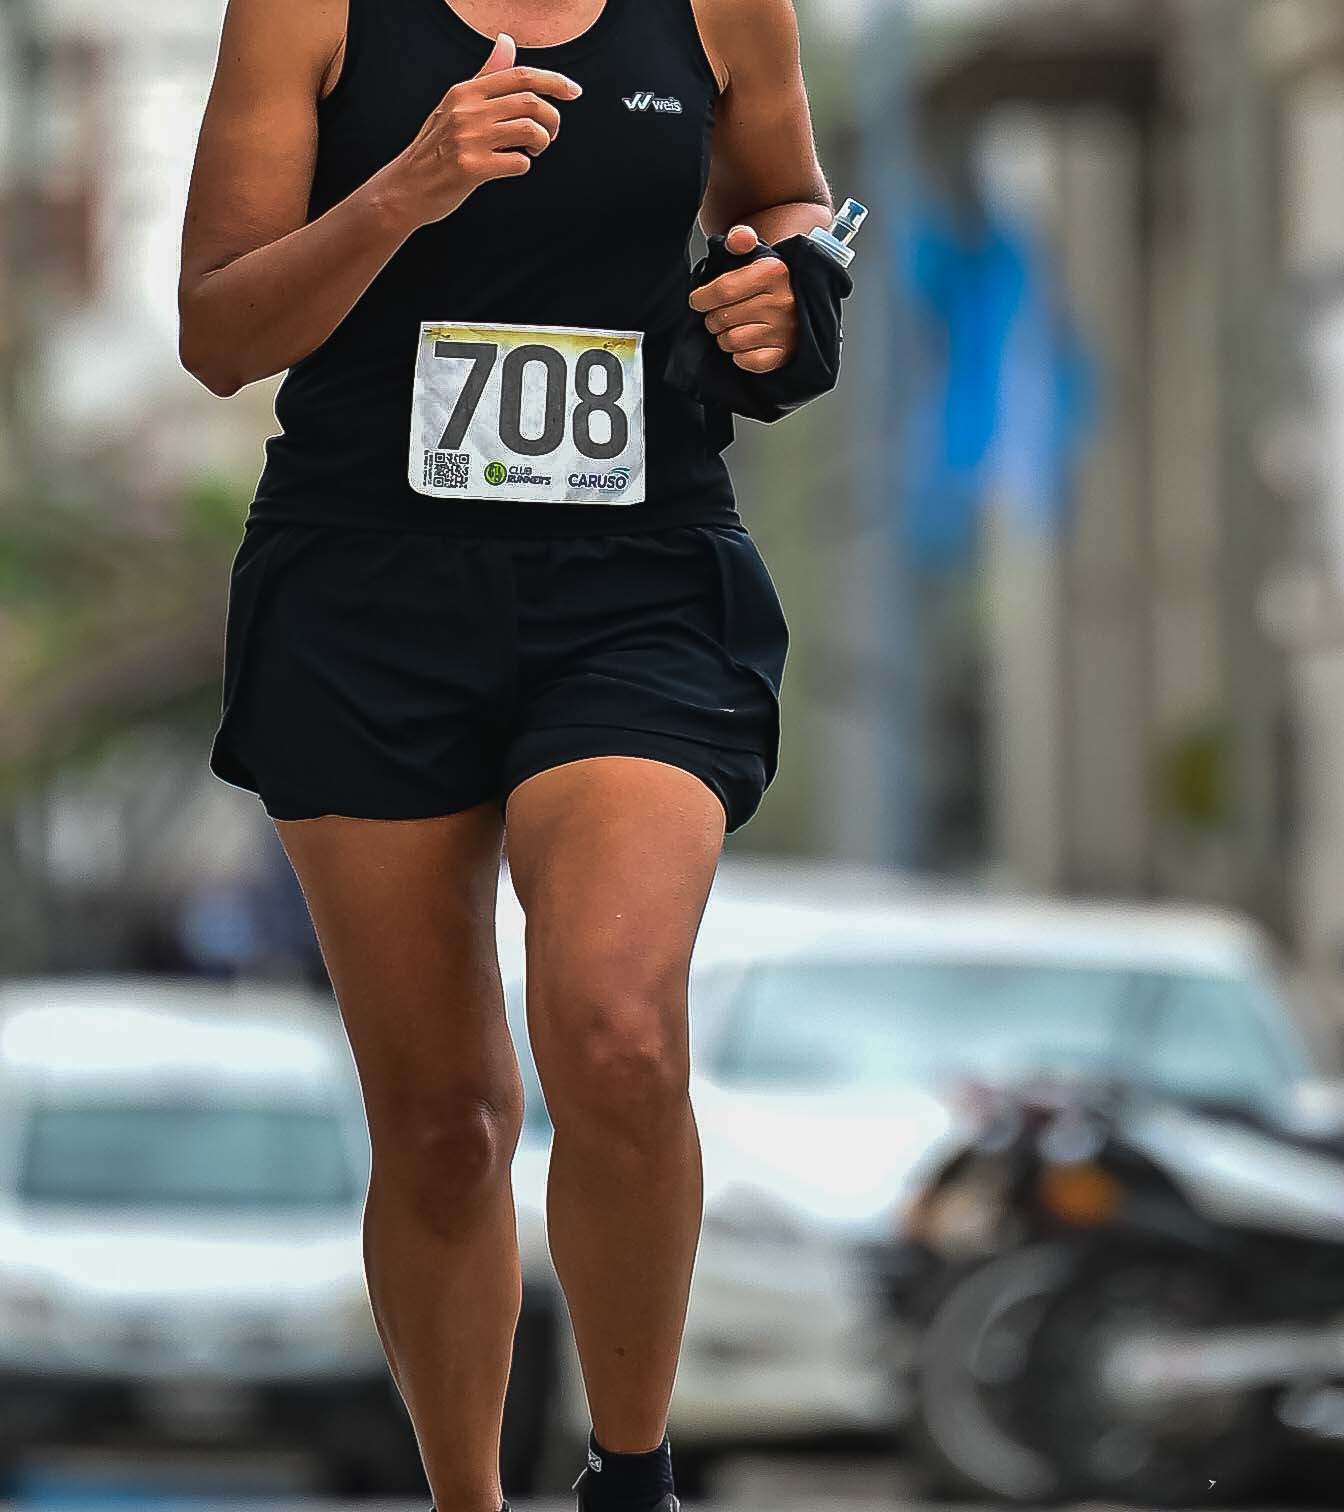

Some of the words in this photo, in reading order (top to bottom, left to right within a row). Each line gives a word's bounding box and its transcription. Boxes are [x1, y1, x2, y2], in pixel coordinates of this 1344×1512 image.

[434, 341, 628, 460] 708
[508, 466, 532, 475] CLUB
[567, 473, 627, 489] CARUSO
